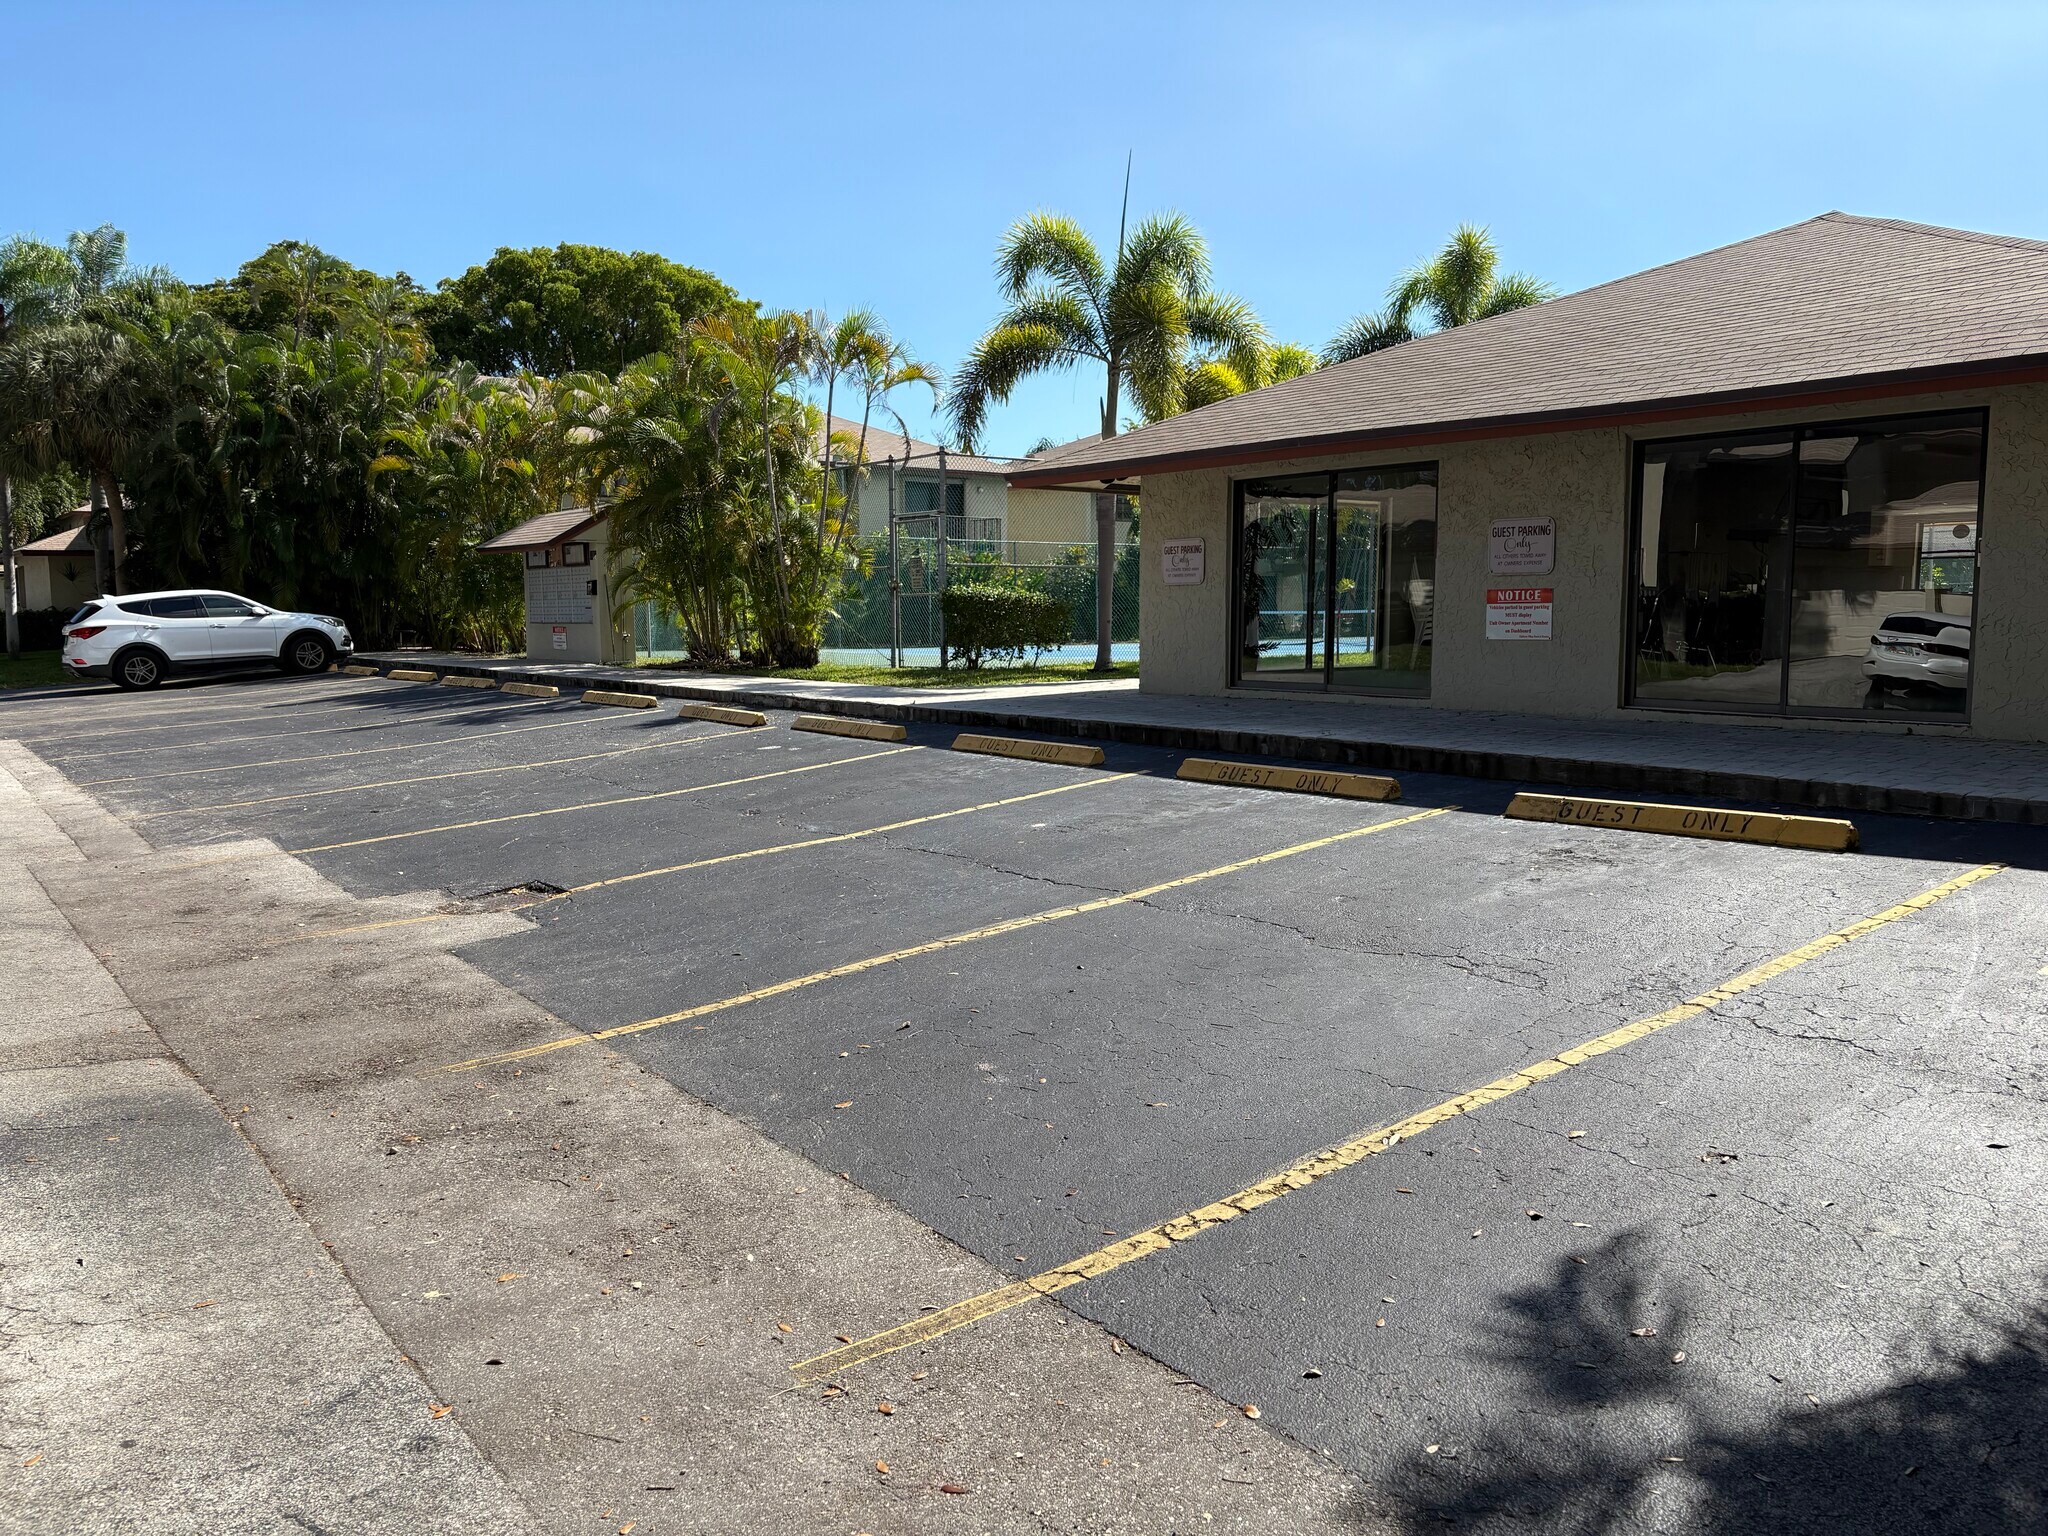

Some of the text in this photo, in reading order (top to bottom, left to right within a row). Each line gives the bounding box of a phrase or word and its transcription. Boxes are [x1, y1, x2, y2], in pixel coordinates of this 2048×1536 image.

[1492, 525, 1551, 538] GUEST PARKING
[1164, 545, 1202, 555] GUEST PARKING
[1504, 536, 1539, 553] Only
[1497, 590, 1541, 601] NOTICE
[979, 738, 1063, 758] GUEST ONLY
[1217, 763, 1343, 793] GUEST ONLY
[1558, 802, 1755, 835] GUEST ONLY
